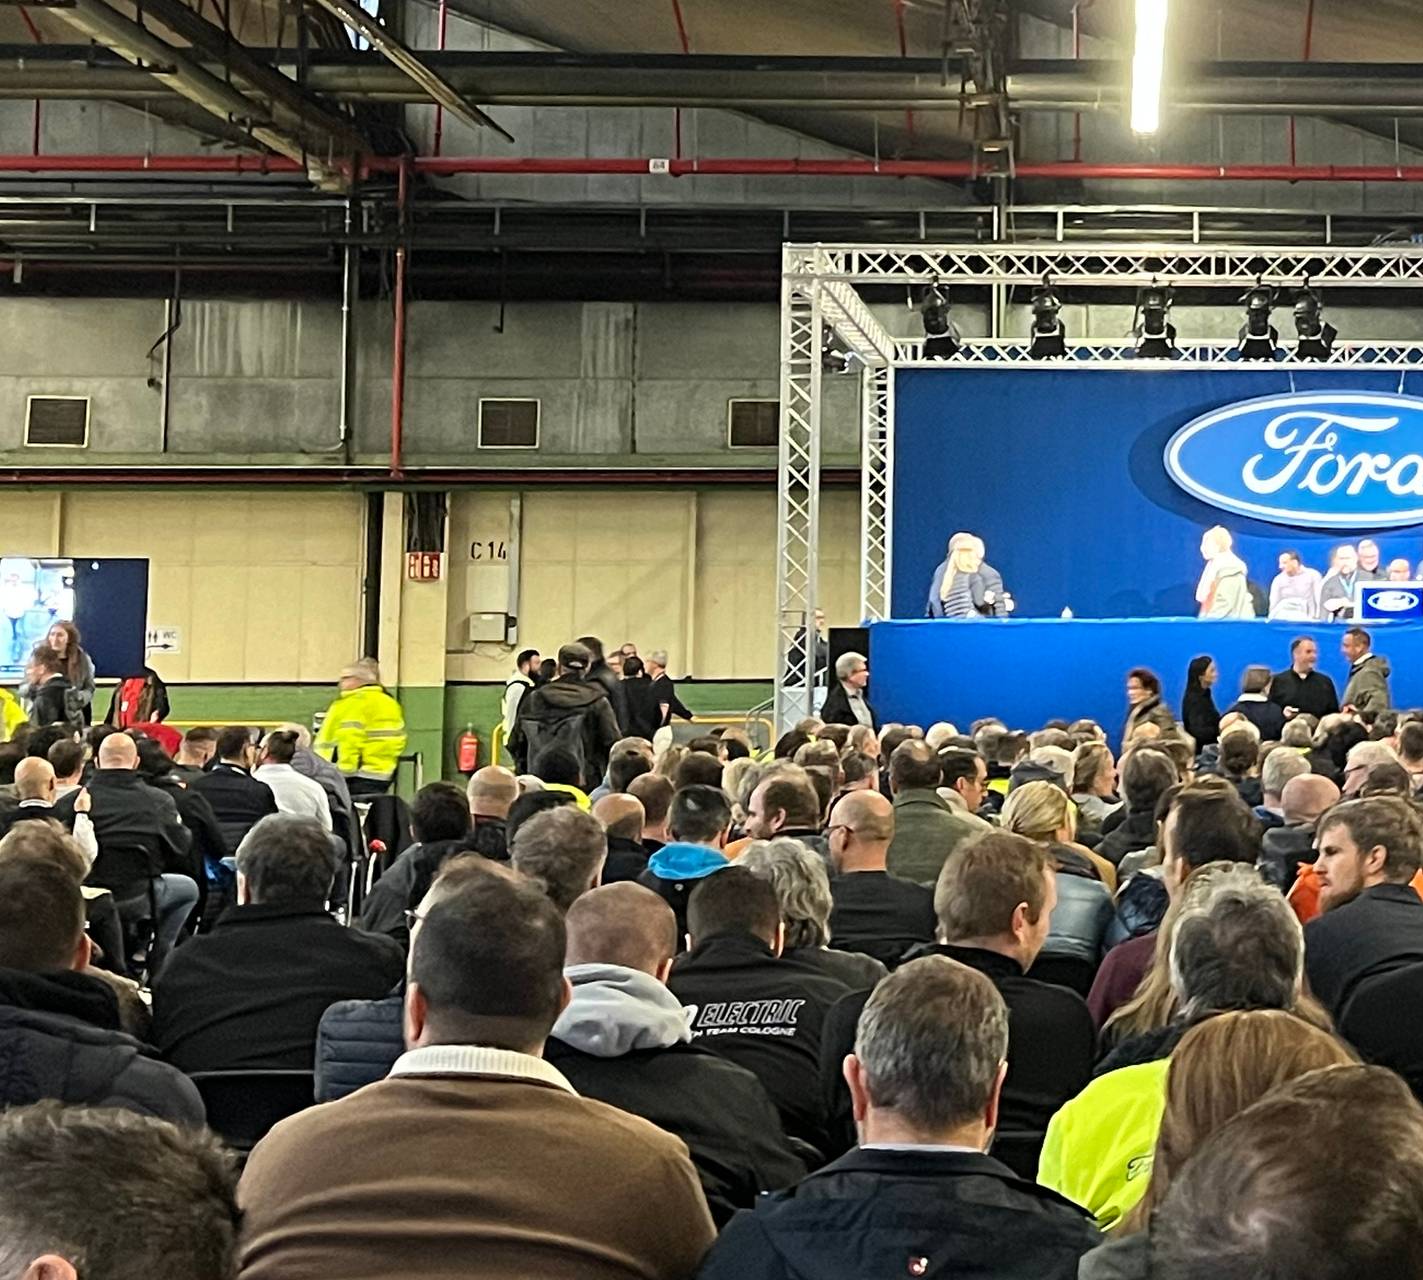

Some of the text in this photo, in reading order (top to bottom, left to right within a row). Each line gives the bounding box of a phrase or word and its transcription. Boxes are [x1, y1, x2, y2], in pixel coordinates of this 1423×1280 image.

[471, 541, 506, 560] C 14
[697, 999, 806, 1027] ELECTRIC
[706, 1027, 739, 1036] TEAM
[740, 1026, 797, 1036] COLOGNE
